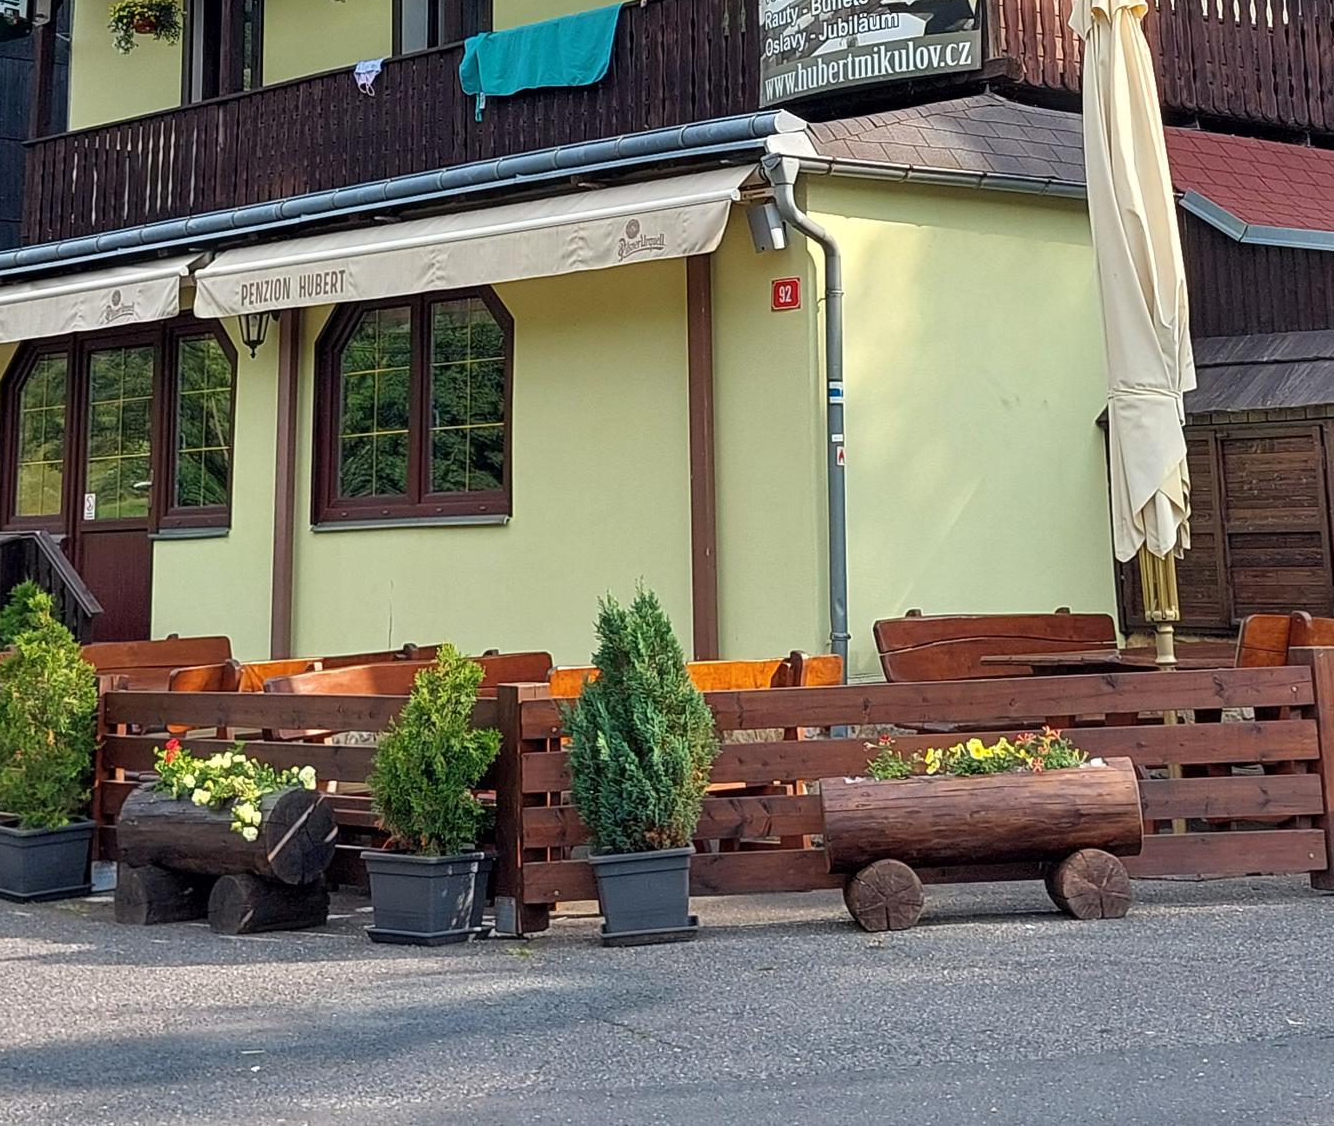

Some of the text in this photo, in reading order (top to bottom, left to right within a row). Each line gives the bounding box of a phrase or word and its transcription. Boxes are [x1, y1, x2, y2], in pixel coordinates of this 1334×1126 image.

[765, 5, 799, 31] Rauty
[765, 31, 807, 58] Oslavy
[818, 12, 900, 42] Jubiläum
[765, 41, 972, 102] www.hubertmikulov.cz
[240, 270, 347, 307] PENZION HUBERT
[778, 284, 793, 304] 92
